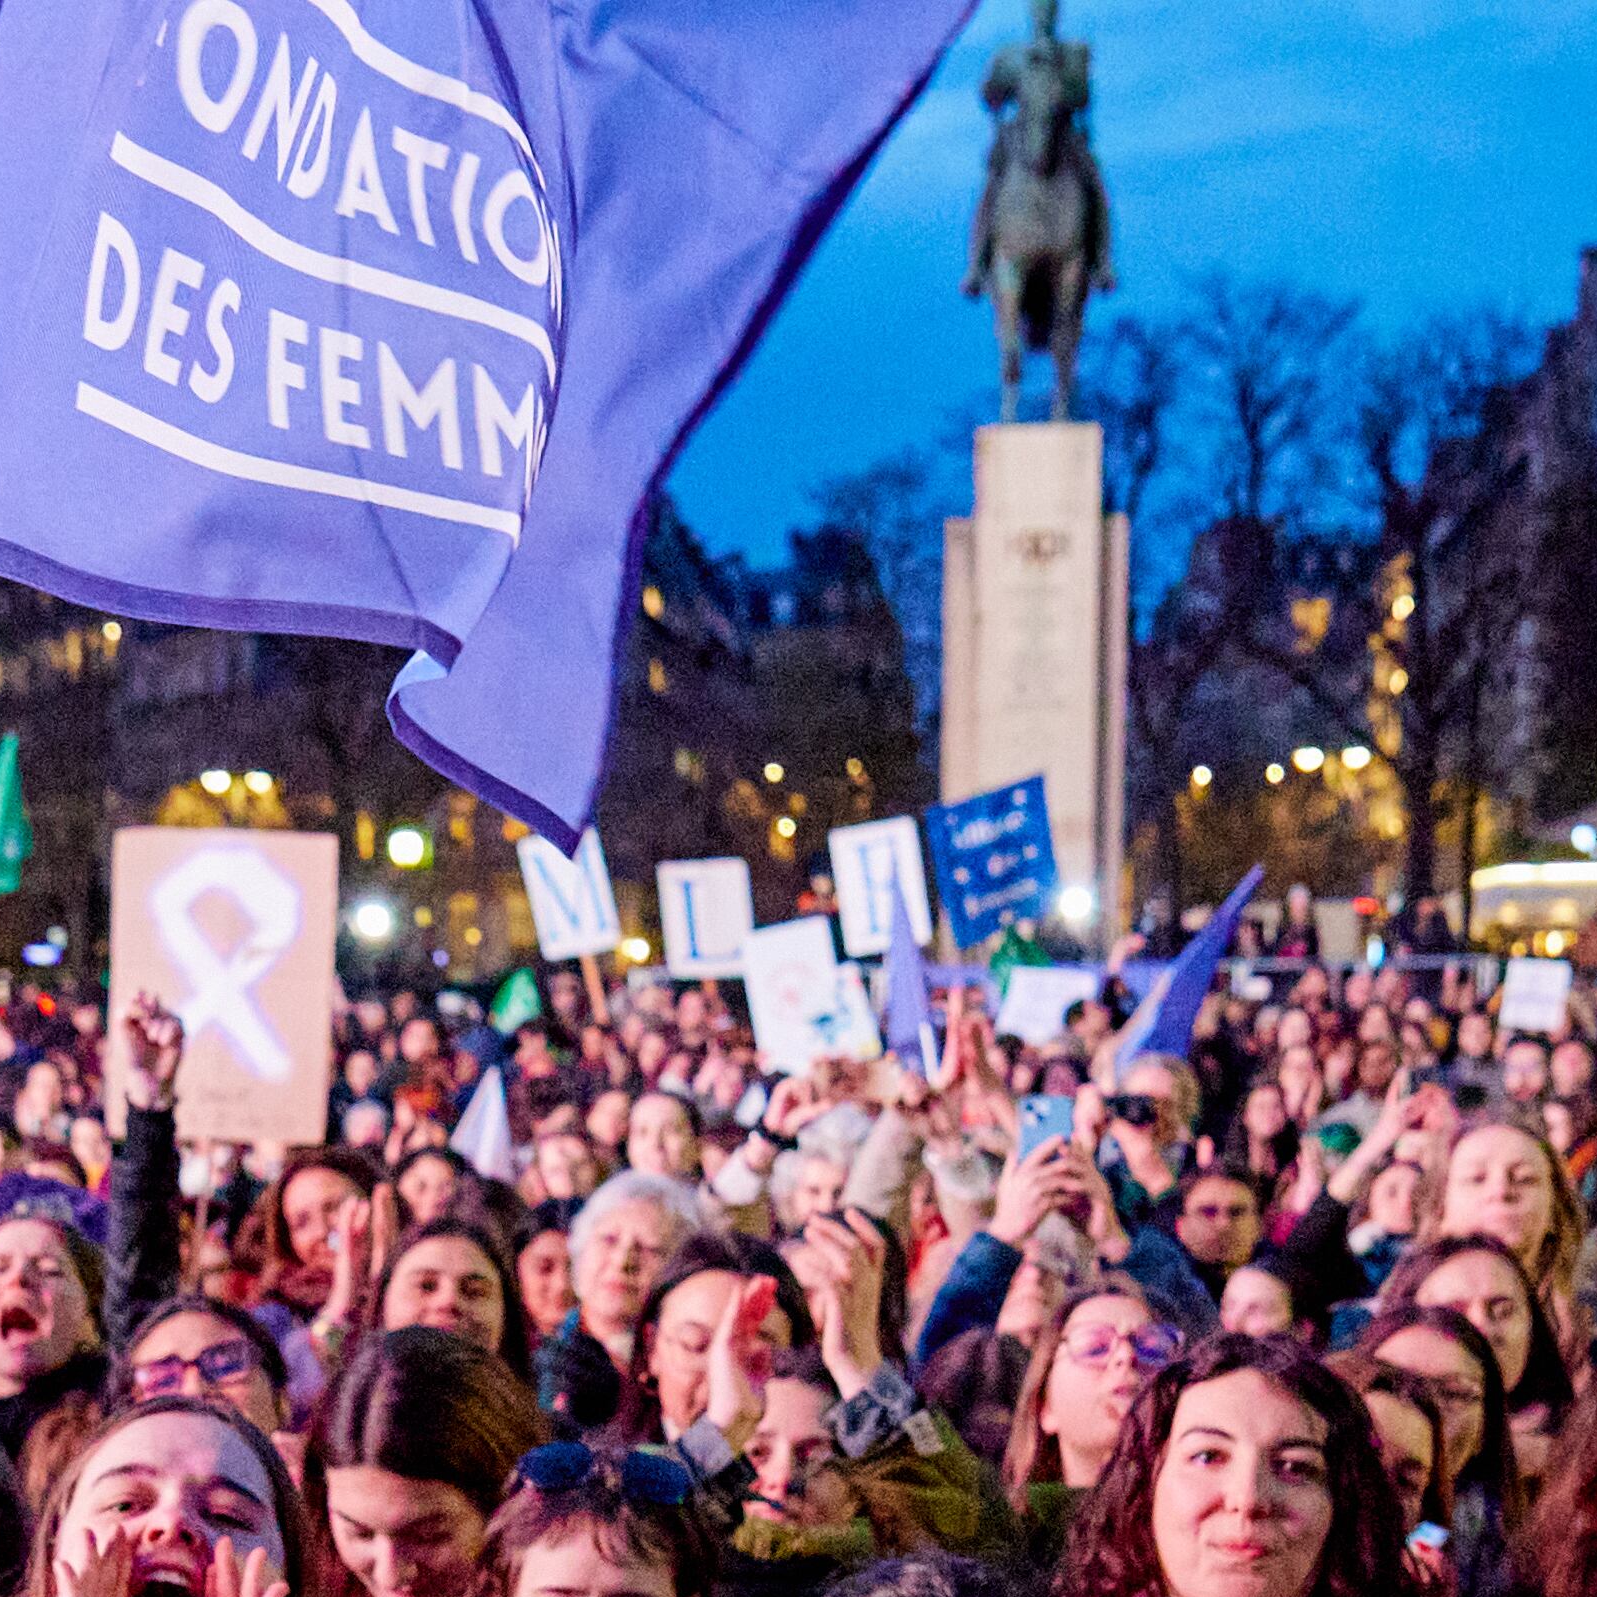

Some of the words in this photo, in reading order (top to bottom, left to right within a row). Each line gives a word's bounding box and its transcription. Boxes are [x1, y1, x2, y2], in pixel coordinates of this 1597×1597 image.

[138, 0, 561, 290] ONDATIO
[83, 211, 242, 404] DES
[267, 309, 543, 490] FEMM
